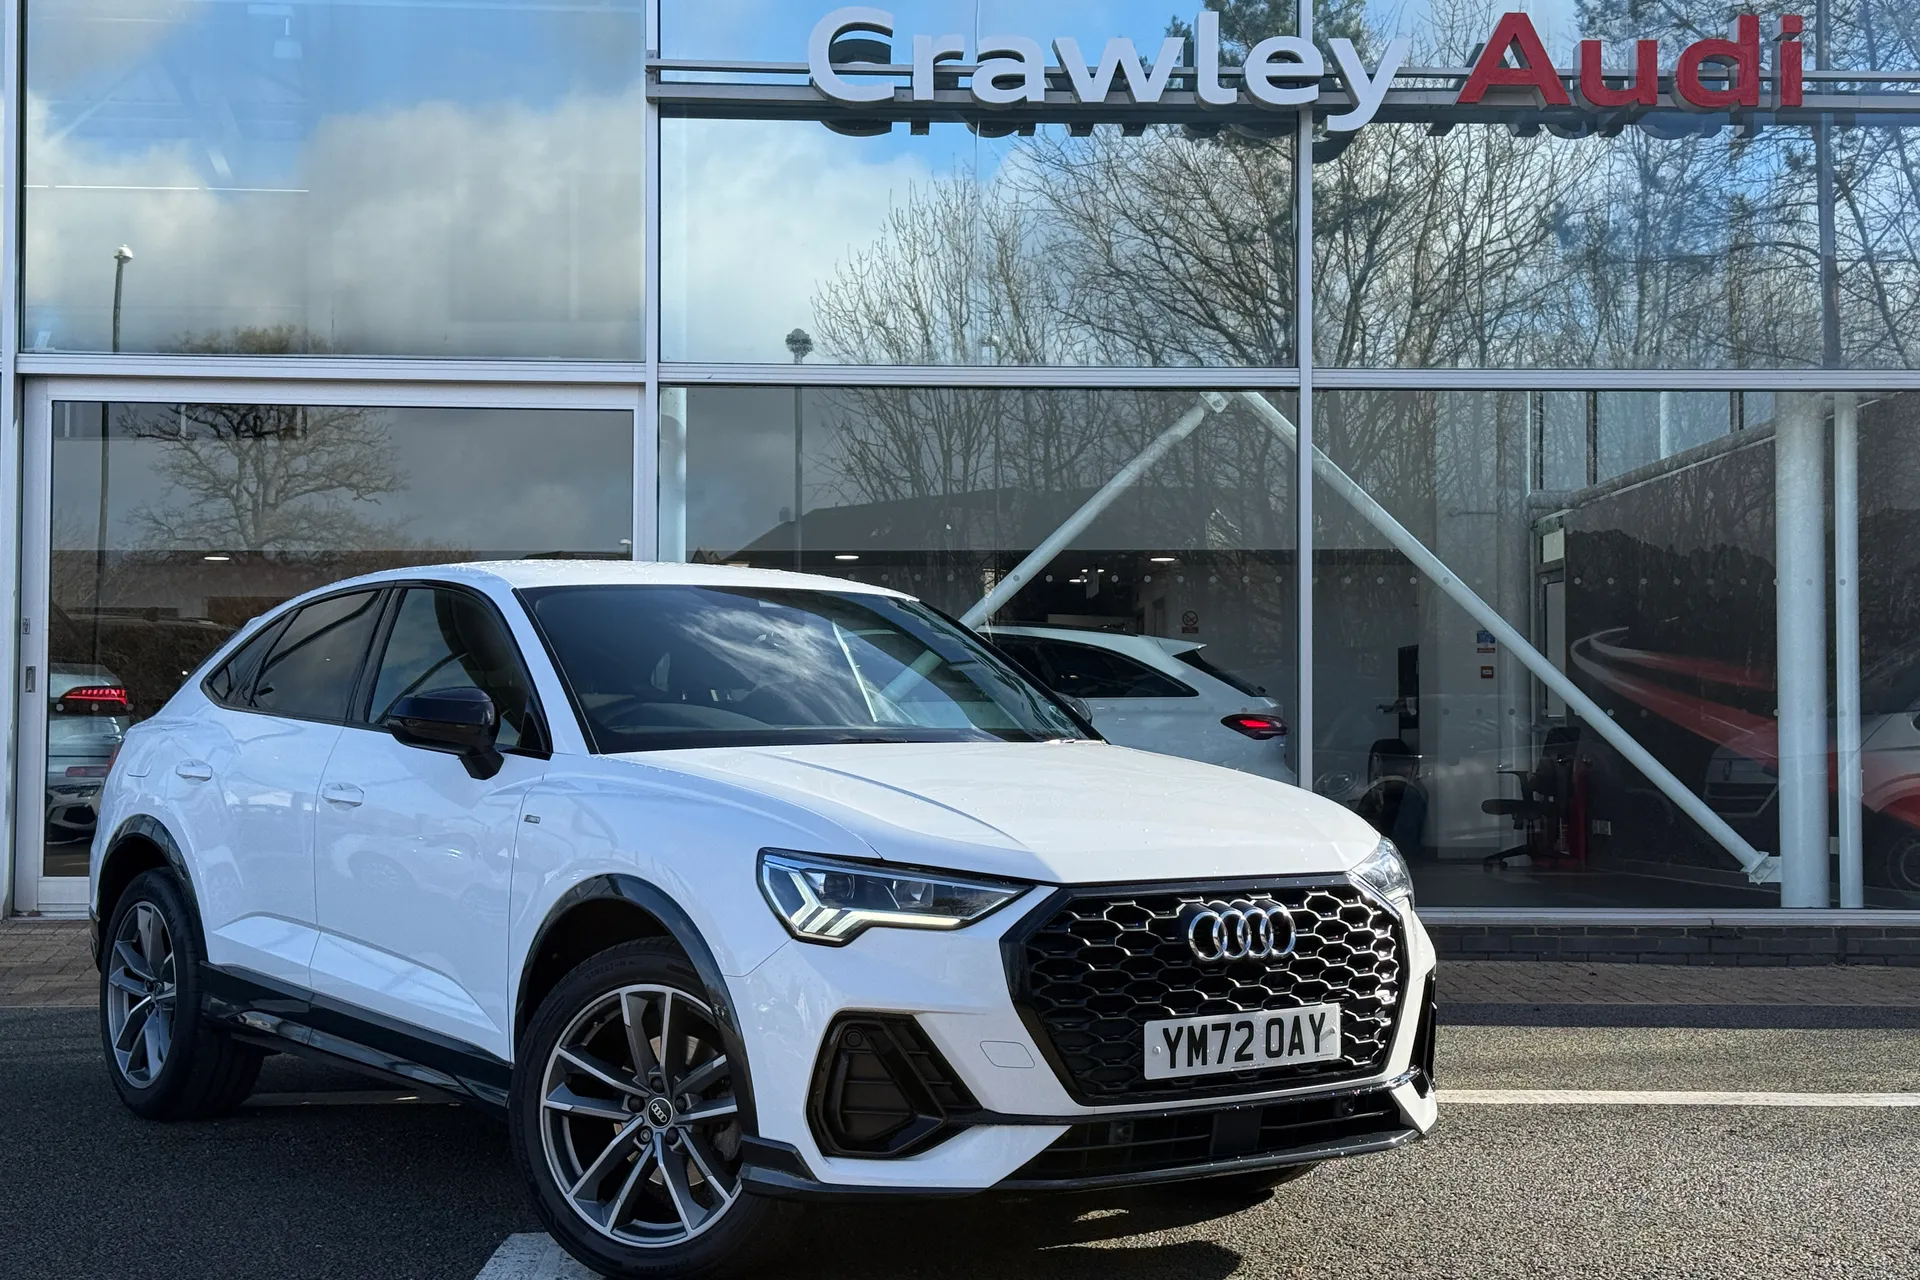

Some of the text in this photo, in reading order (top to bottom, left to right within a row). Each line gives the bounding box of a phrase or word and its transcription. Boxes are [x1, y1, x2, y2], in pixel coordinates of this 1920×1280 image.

[807, 5, 1803, 132] Crawley Audi
[1162, 1012, 1326, 1069] YM72 OAY
